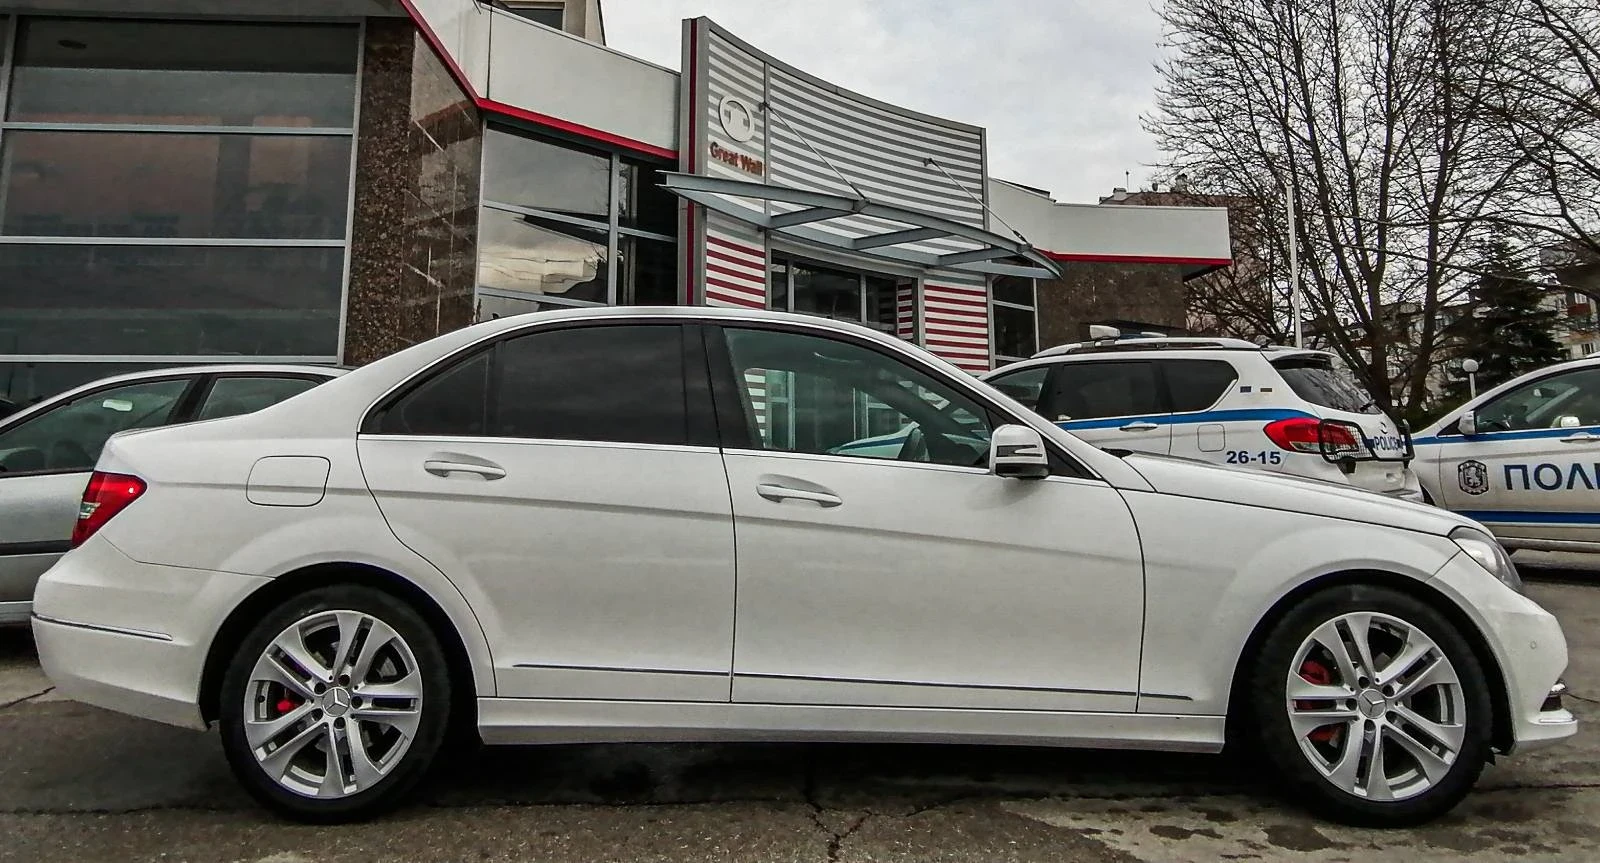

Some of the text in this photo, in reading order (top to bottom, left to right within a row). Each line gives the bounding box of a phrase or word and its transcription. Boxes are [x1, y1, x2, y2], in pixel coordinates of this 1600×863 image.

[710, 141, 763, 176] Great Wall
[1226, 451, 1281, 465] 26-15
[1504, 463, 1600, 490] ПОЛ
